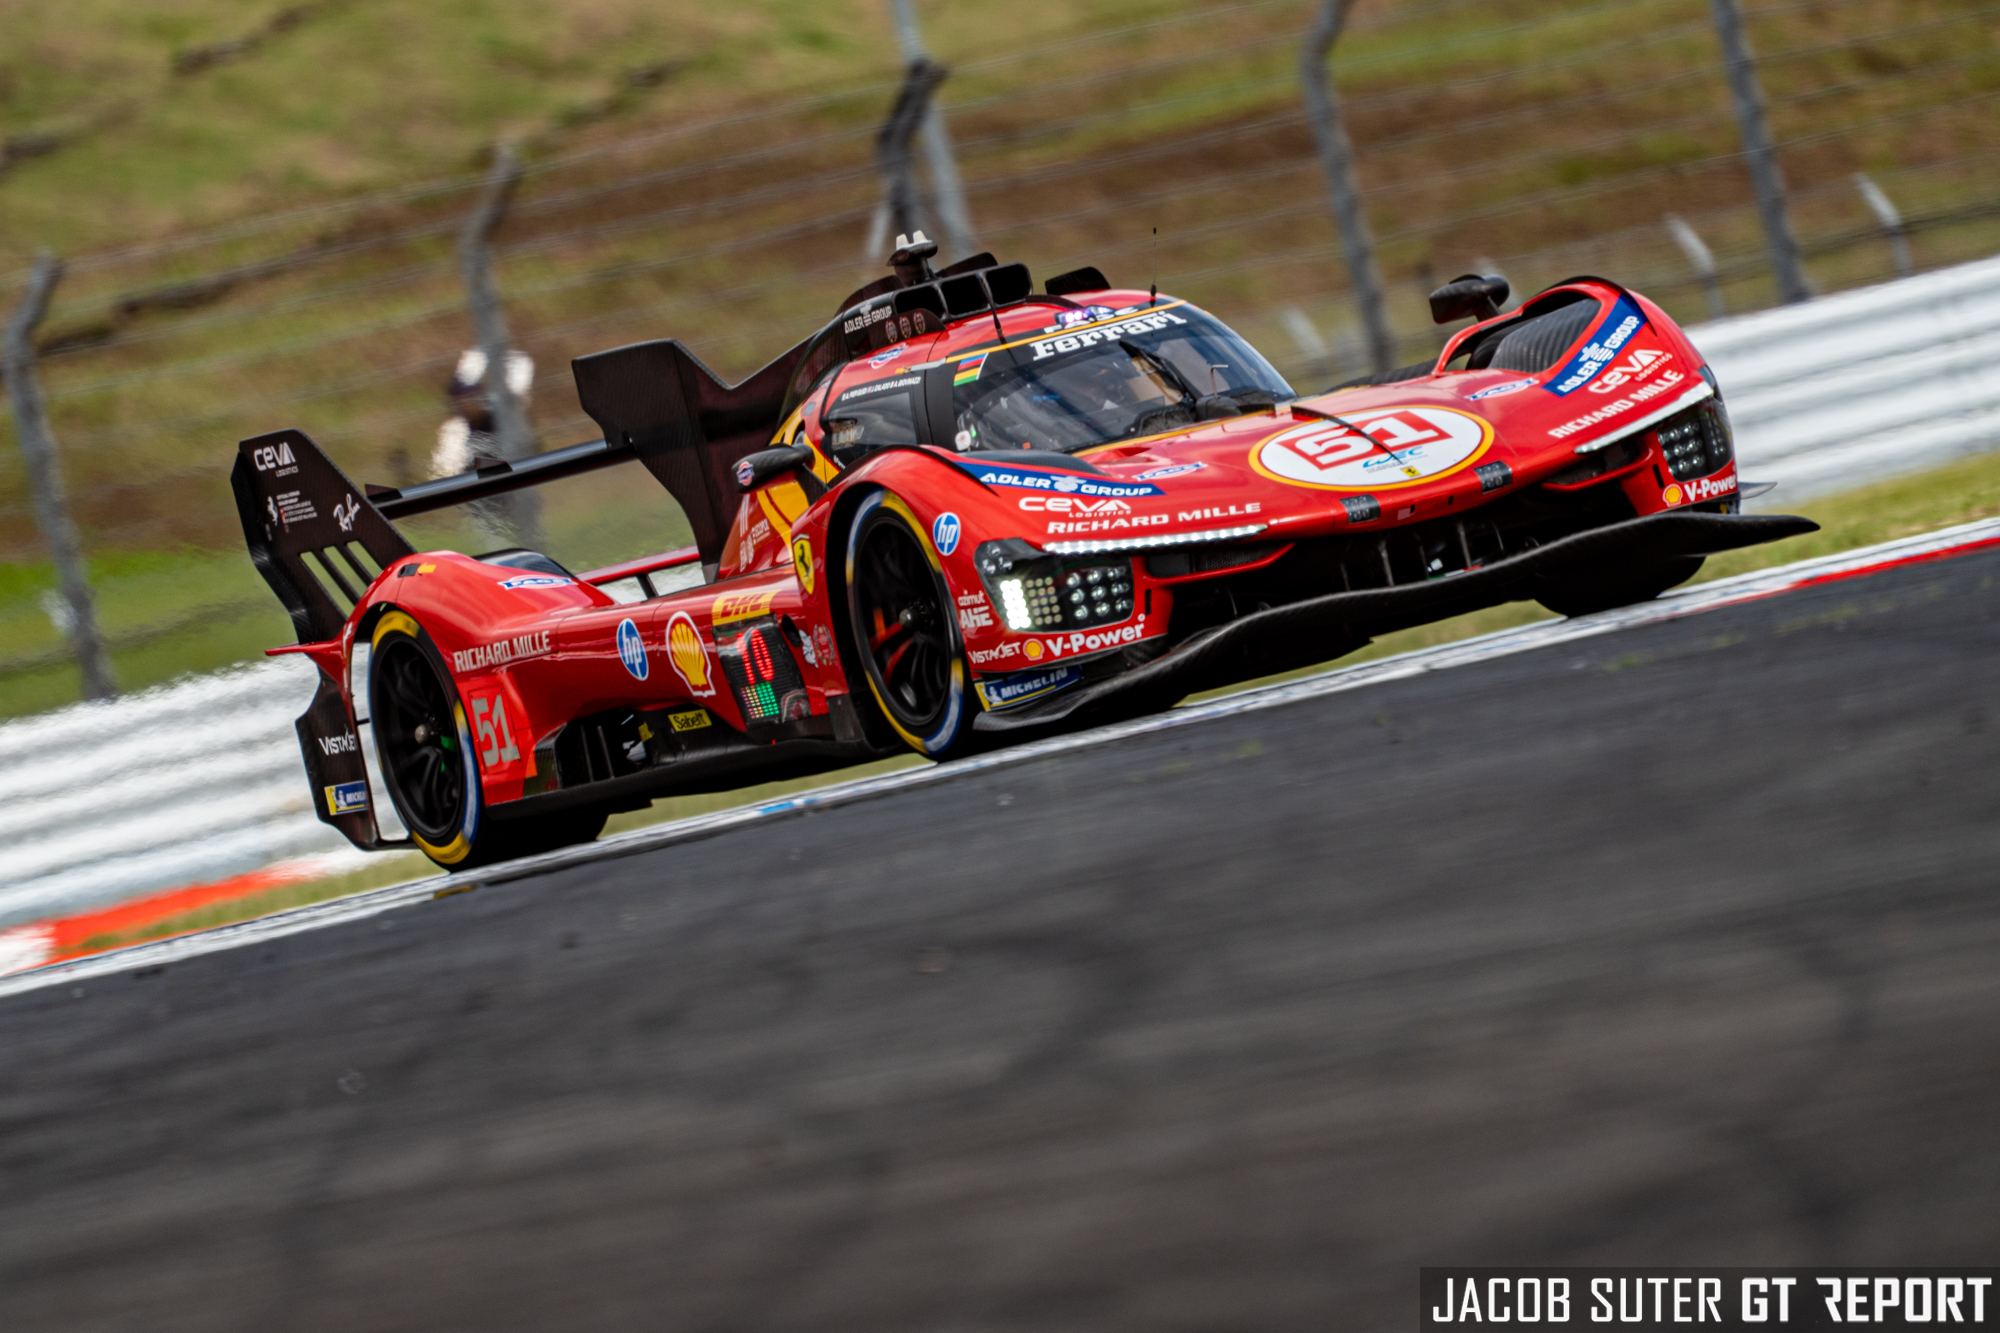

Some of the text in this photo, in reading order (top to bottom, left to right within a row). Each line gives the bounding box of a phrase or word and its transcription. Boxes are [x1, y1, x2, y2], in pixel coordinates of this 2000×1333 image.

[844, 316, 865, 334] ADLER
[871, 305, 892, 323] GROUP
[1028, 310, 1188, 361] Ferrari
[1557, 315, 1640, 393] ADLER GROUP
[1635, 352, 1673, 382] LOGISTICS
[1548, 369, 1684, 438] RICHARD MILLE
[1295, 416, 1440, 465] 51
[980, 472, 1152, 497] ADLER GROUP
[1684, 474, 1737, 502] V-Power
[1047, 502, 1261, 534] RICHARD MILLE
[1069, 510, 1132, 519] LOGISTICS
[936, 513, 959, 555] hp
[453, 630, 552, 673] RICHARD MILLE
[620, 619, 645, 680] hp
[1046, 623, 1145, 657] V-Power
[1001, 667, 1068, 698] MICHELIN
[471, 694, 521, 767] 51
